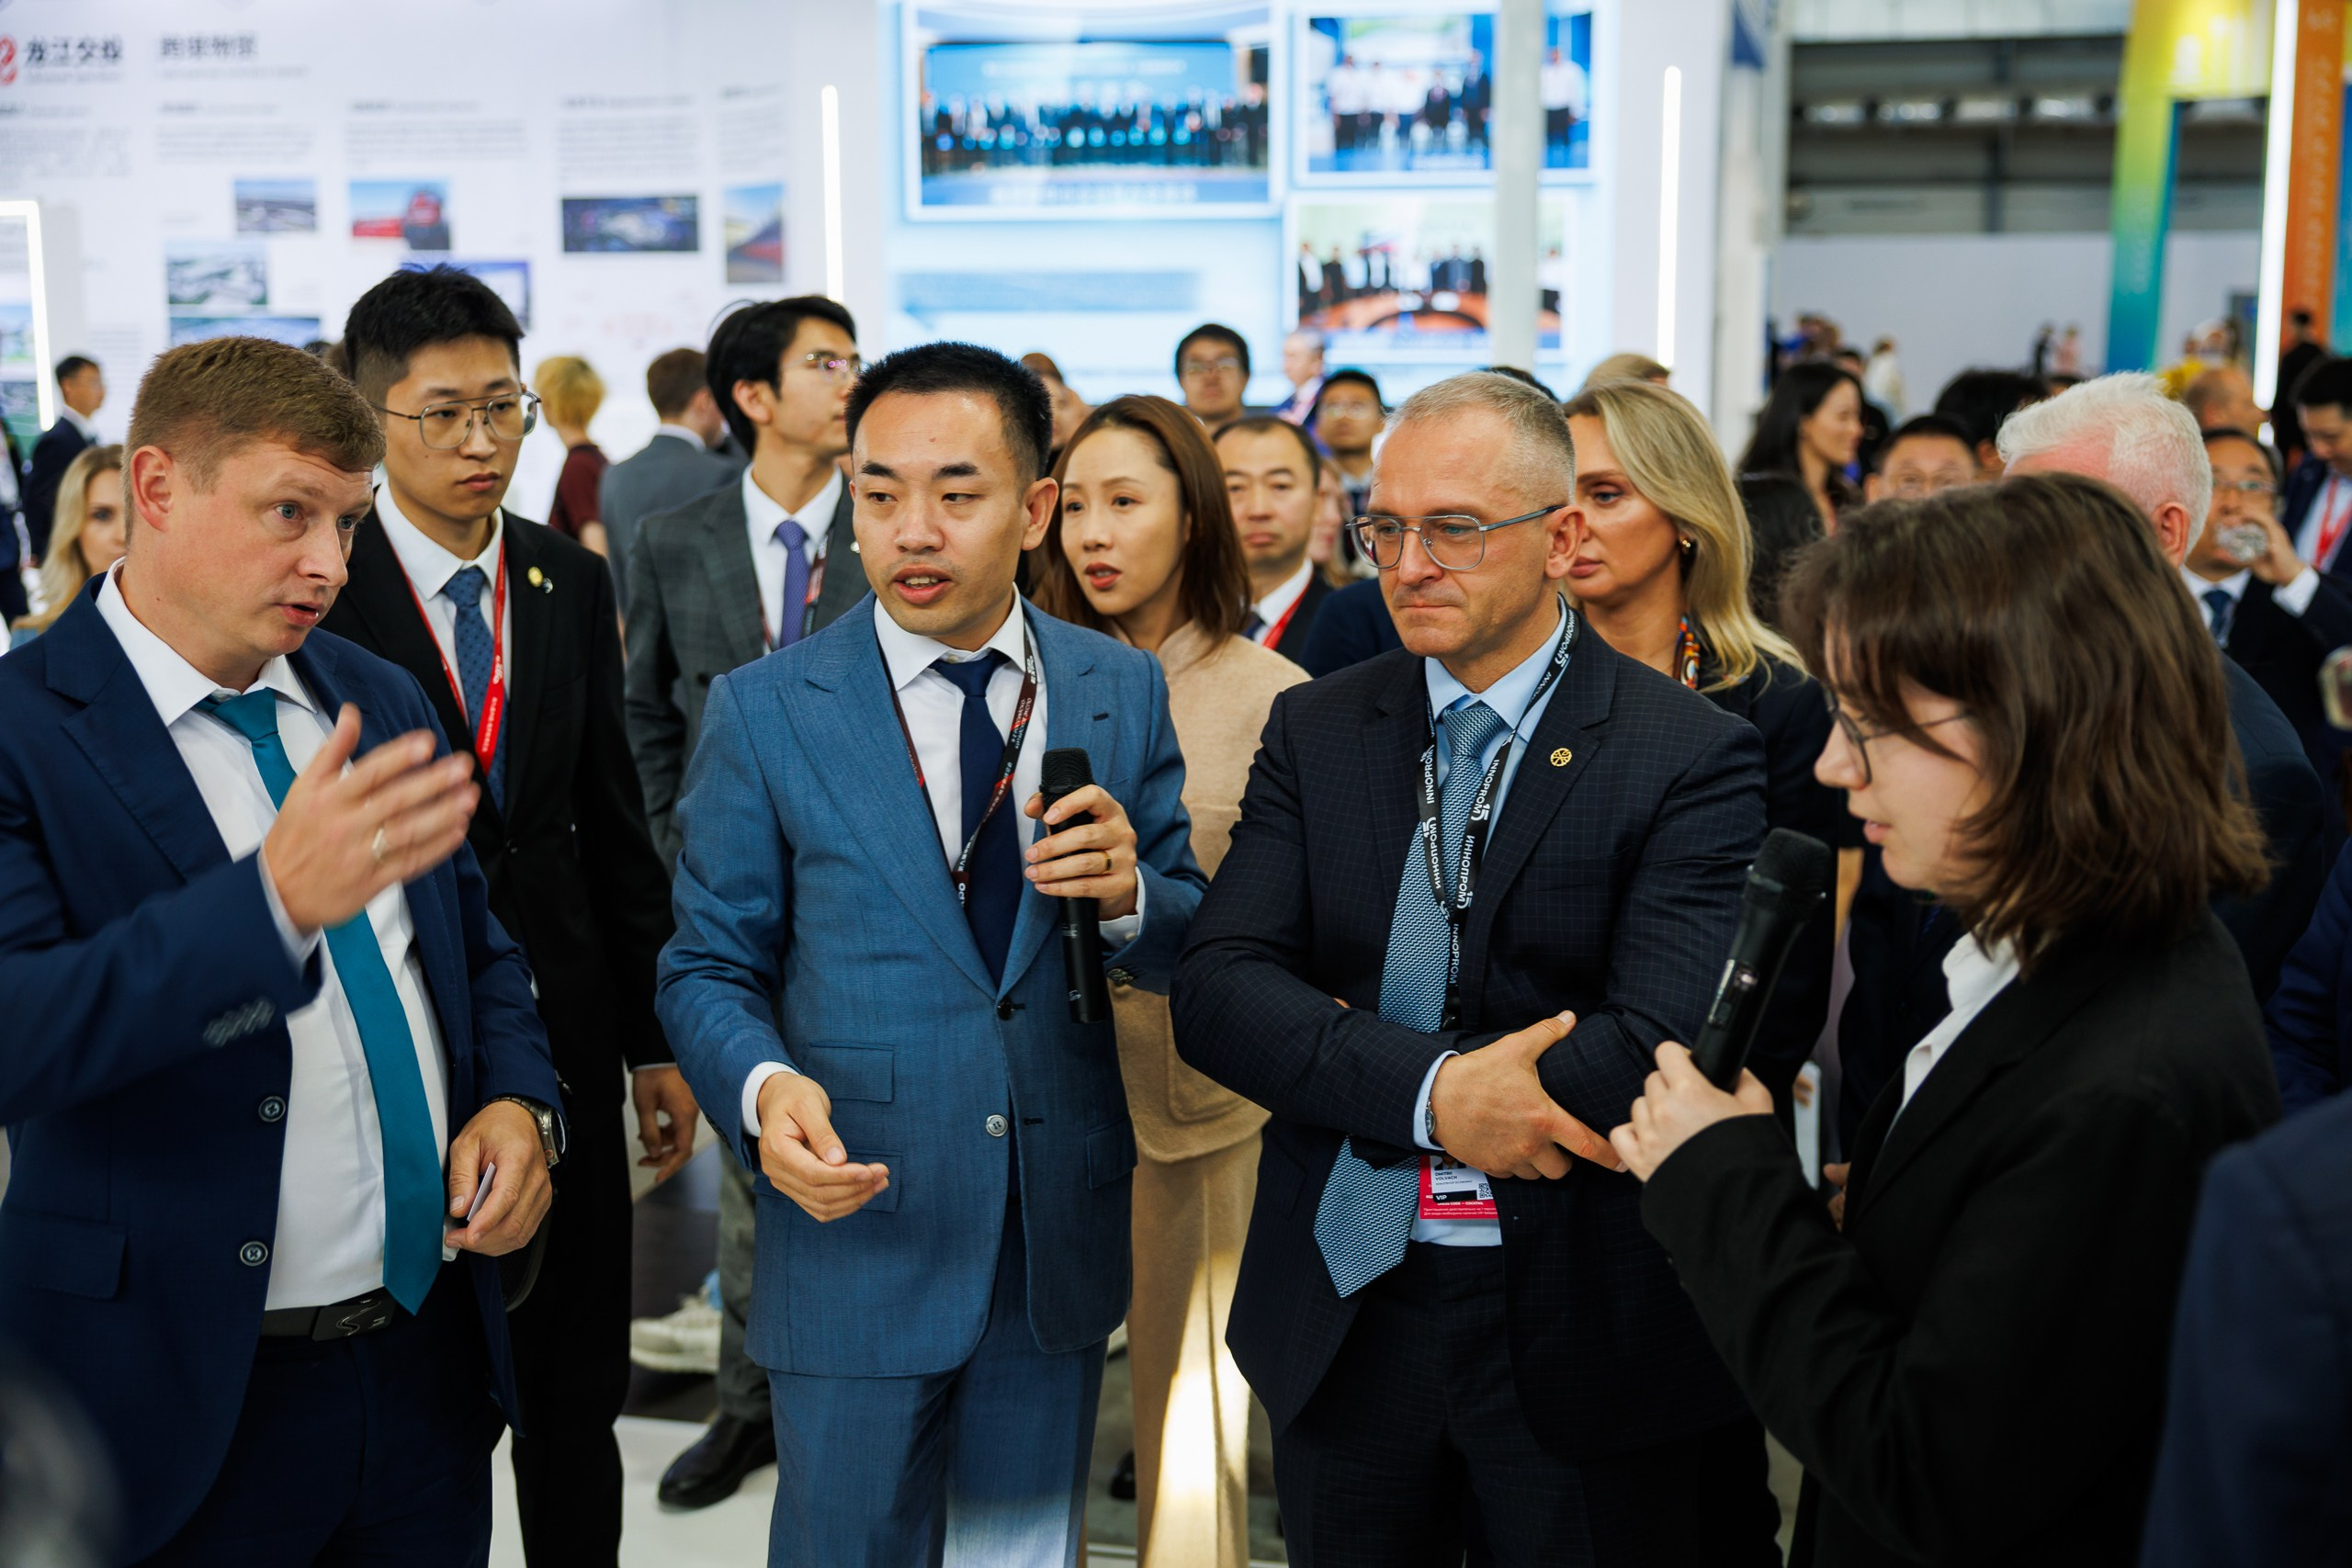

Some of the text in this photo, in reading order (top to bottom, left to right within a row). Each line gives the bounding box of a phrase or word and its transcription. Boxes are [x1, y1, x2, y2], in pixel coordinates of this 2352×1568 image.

[1424, 749, 1435, 804] INNOPROM
[1472, 759, 1500, 814] INNOPROM
[1430, 823, 1442, 889] ИННОПРОМ
[1457, 834, 1476, 902] ИННОПРОМ
[1449, 923, 1460, 984] INNOPROM
